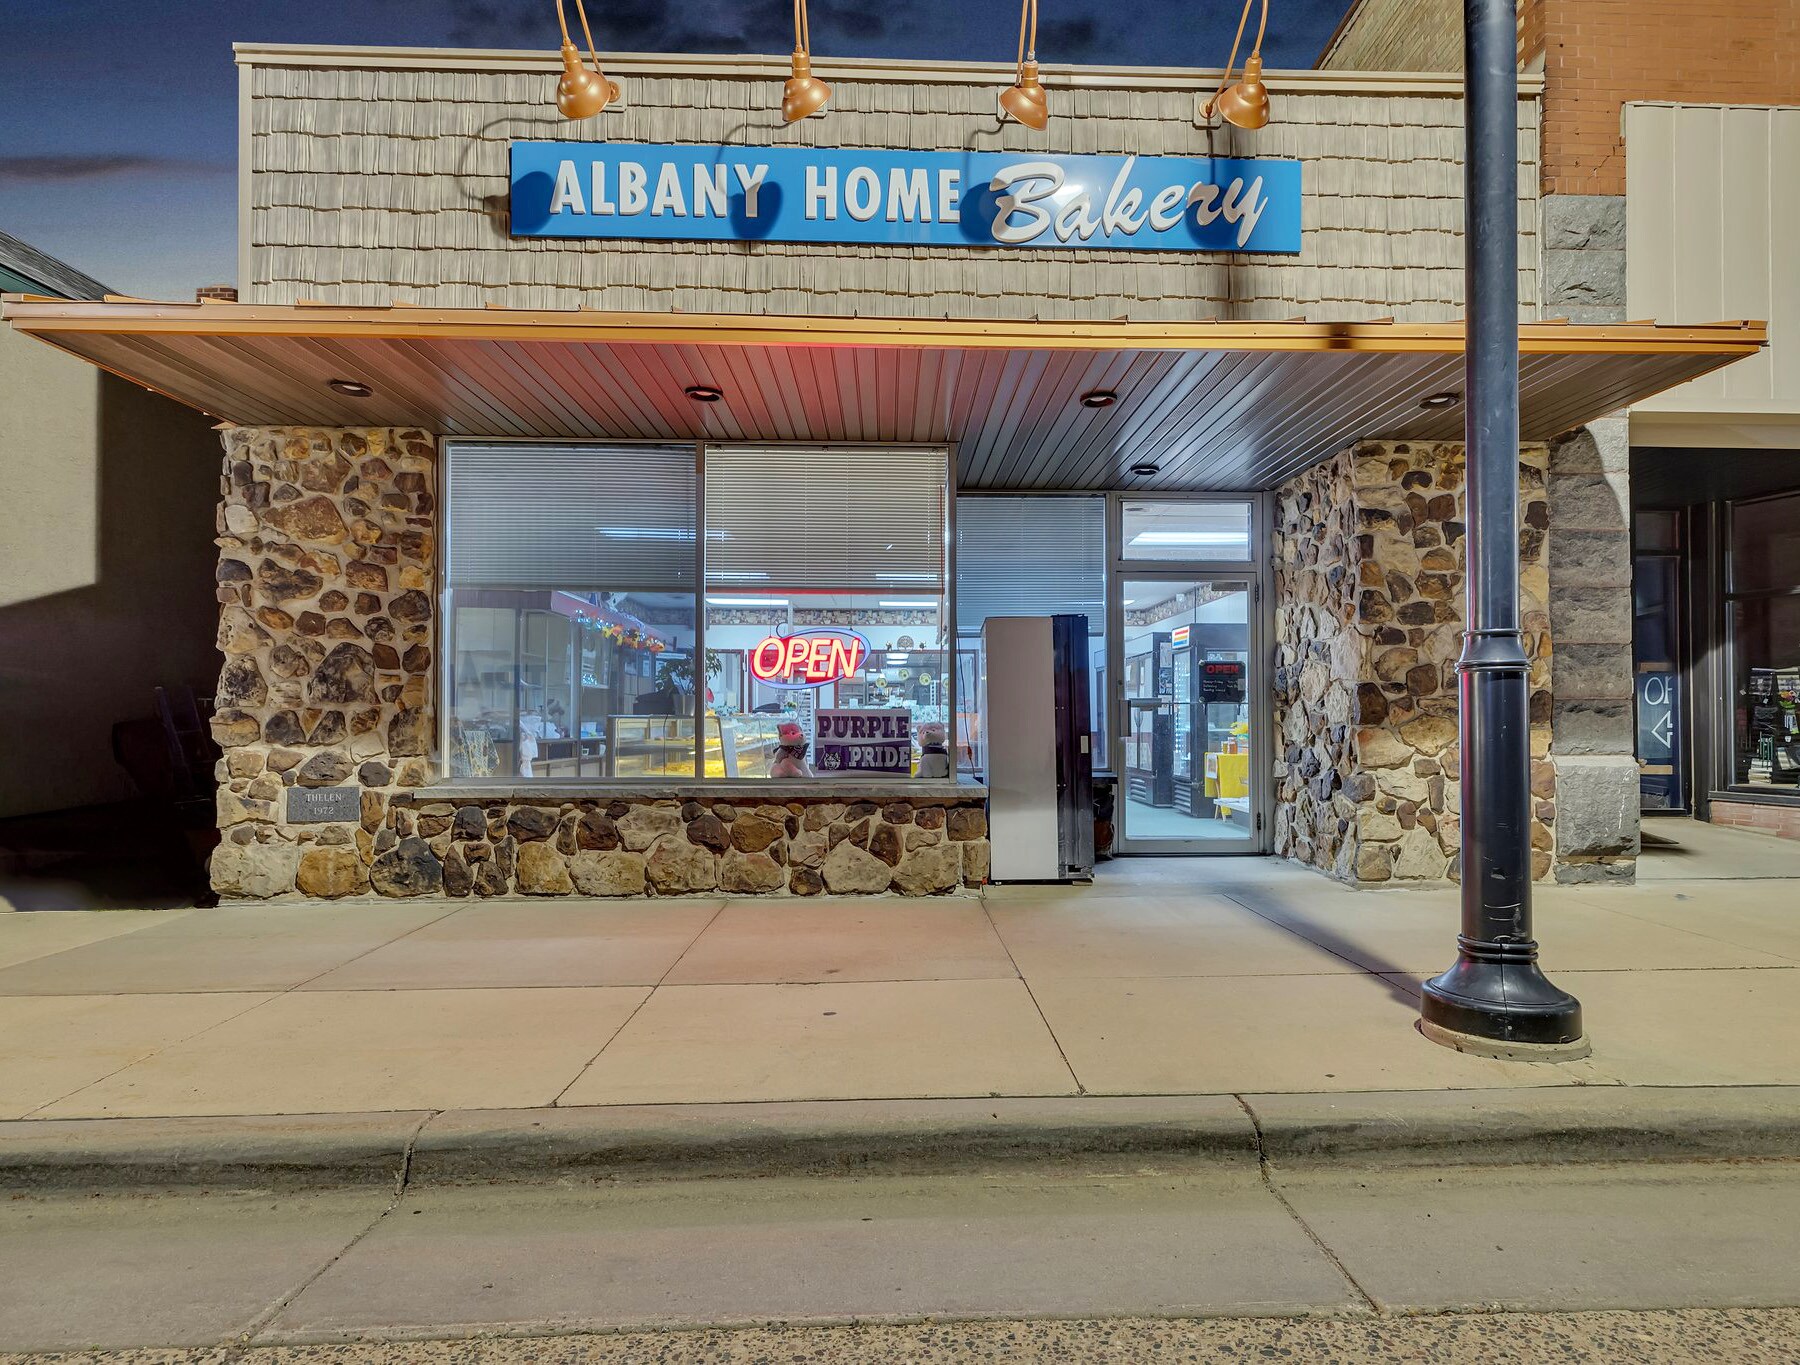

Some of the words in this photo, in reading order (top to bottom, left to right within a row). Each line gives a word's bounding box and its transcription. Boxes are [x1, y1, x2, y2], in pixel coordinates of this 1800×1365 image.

[549, 159, 769, 218] ALBANY
[804, 165, 961, 223] HOME
[989, 154, 1269, 249] Bakery
[752, 636, 861, 679] OPEN
[1206, 664, 1239, 674] OPEN
[817, 715, 910, 739] PURPLE
[848, 746, 910, 768] PRIDE
[305, 793, 342, 802] THELEN
[313, 806, 334, 815] 1972
